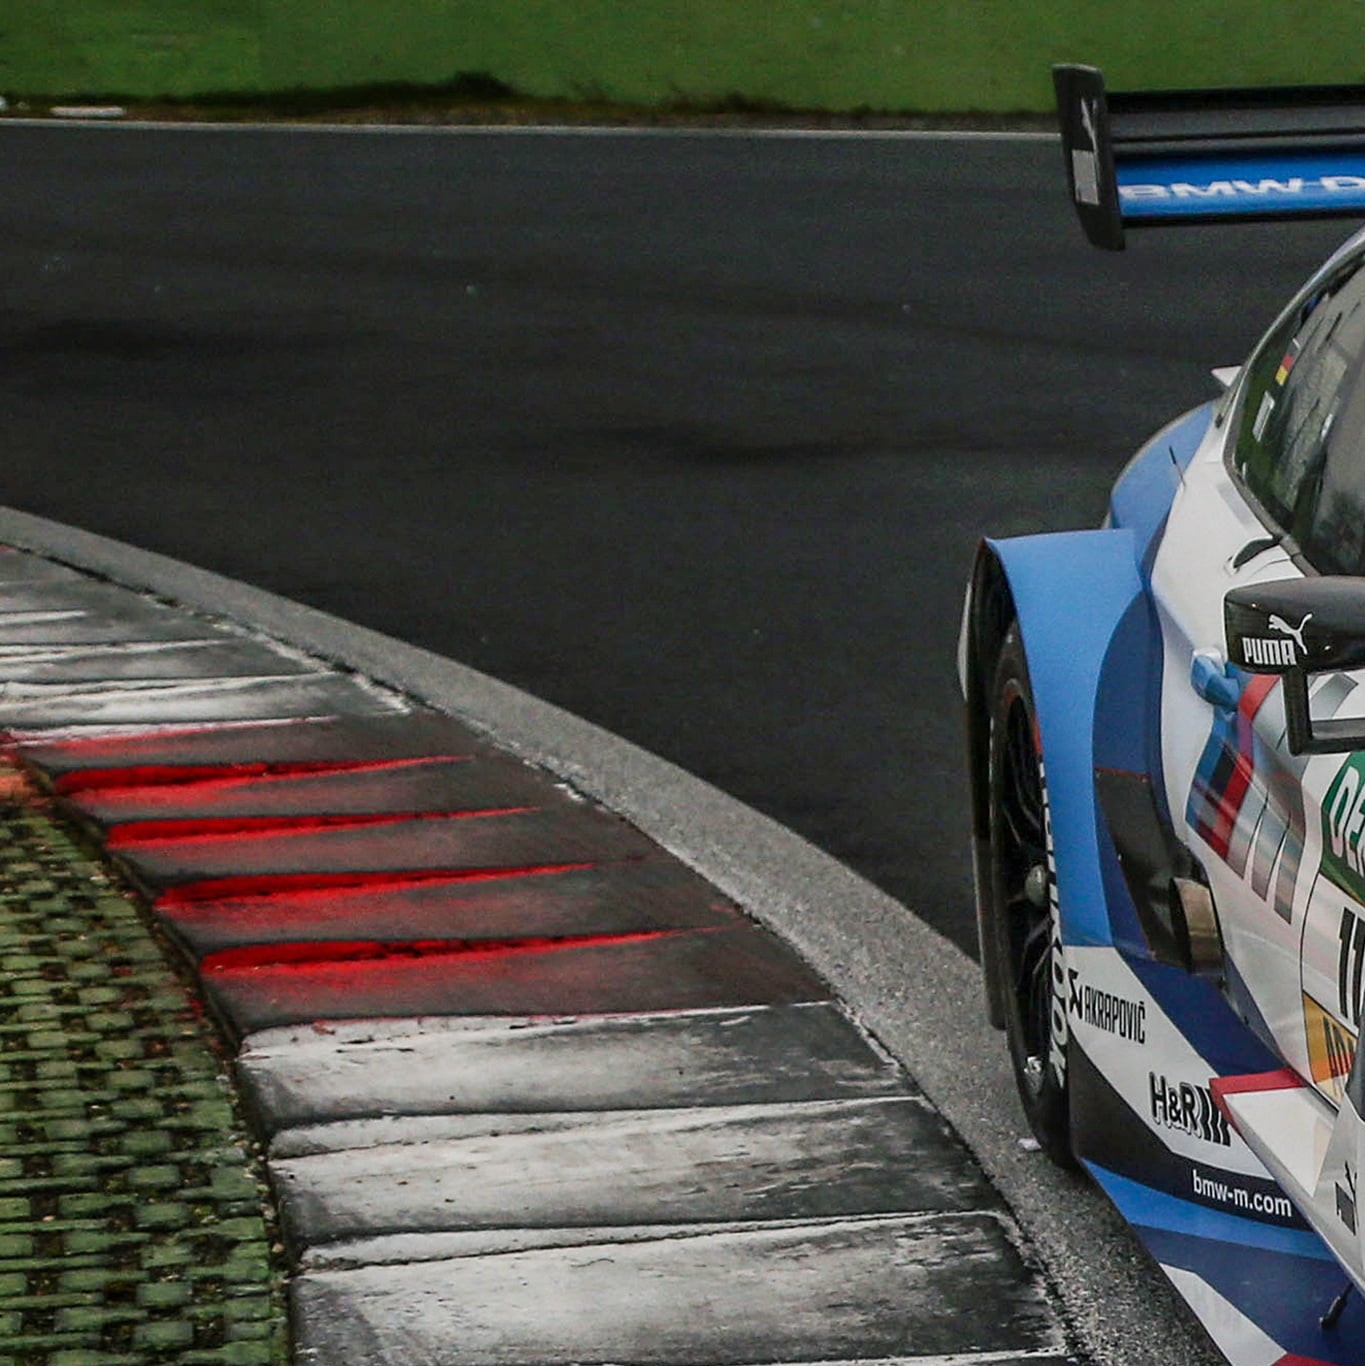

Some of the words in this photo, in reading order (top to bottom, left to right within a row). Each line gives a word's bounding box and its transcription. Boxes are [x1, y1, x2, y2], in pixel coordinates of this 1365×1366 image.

[1118, 170, 1302, 199] BMW
[1242, 637, 1298, 666] PUMA
[1150, 1072, 1202, 1139] H&R
[1192, 1168, 1292, 1218] bmw-m.com
